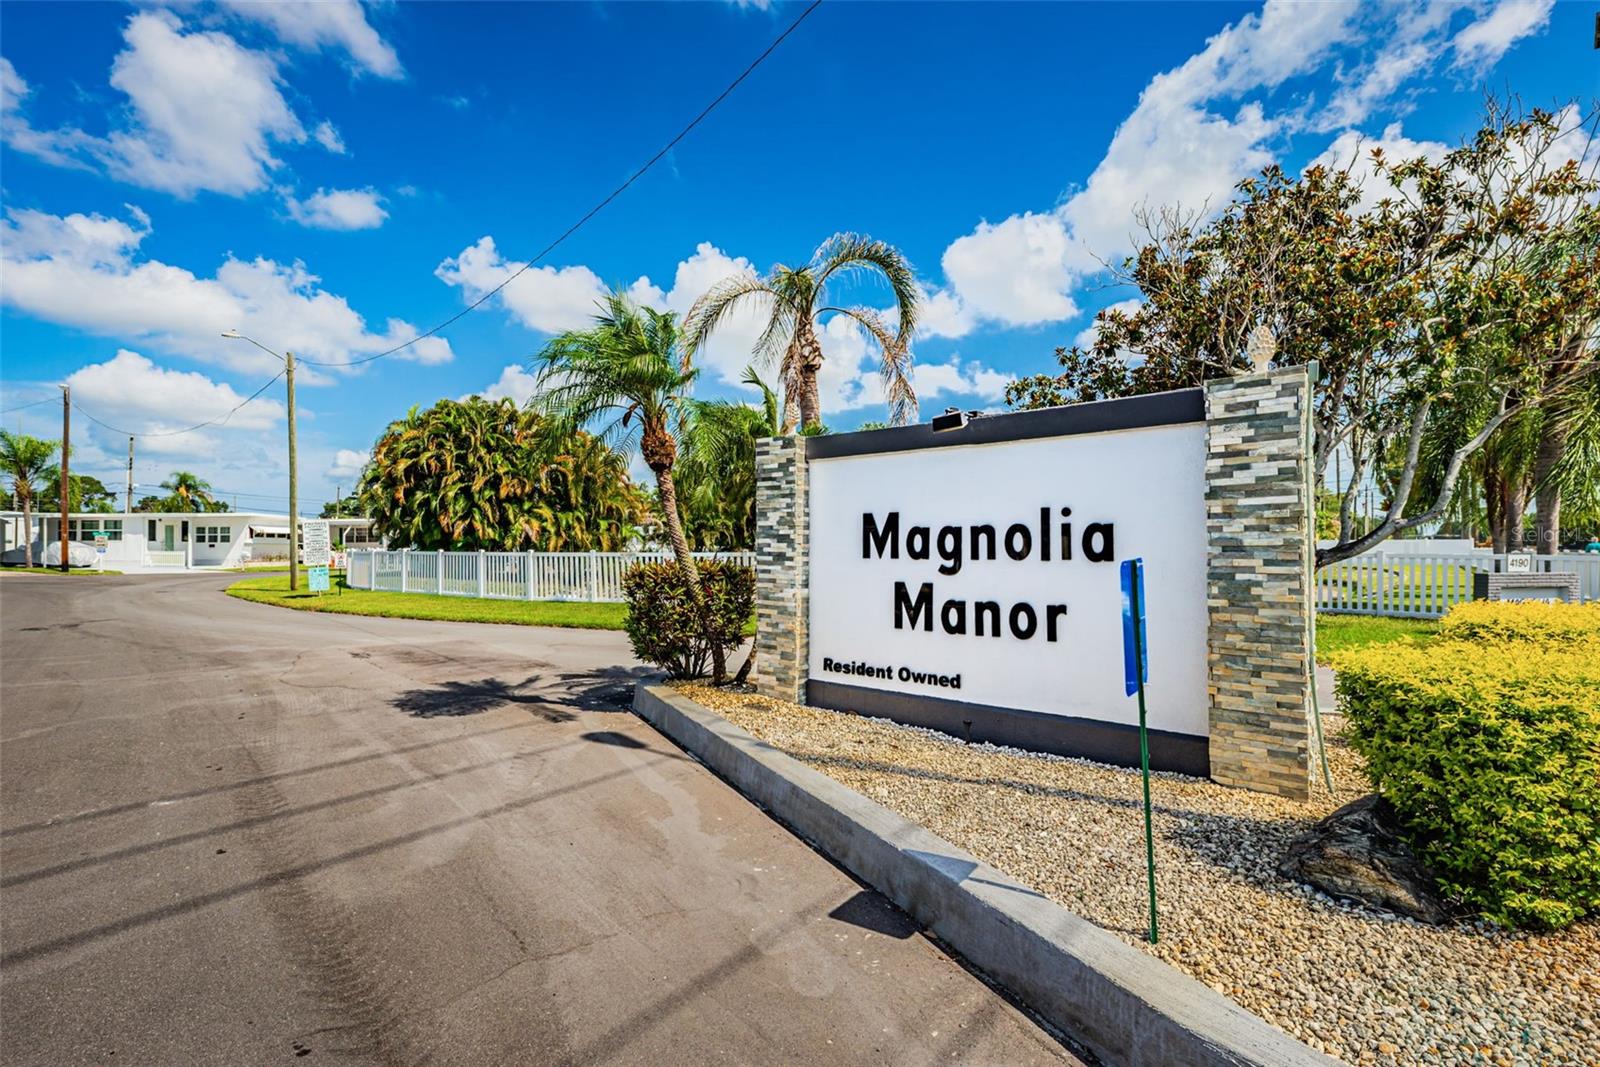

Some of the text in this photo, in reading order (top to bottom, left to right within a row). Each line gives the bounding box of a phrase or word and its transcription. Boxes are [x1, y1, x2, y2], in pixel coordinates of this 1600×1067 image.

[863, 507, 1115, 575] Magnolia
[1510, 558, 1528, 568] 4190
[895, 582, 1067, 642] Manor
[823, 657, 962, 690] Resident Owned
